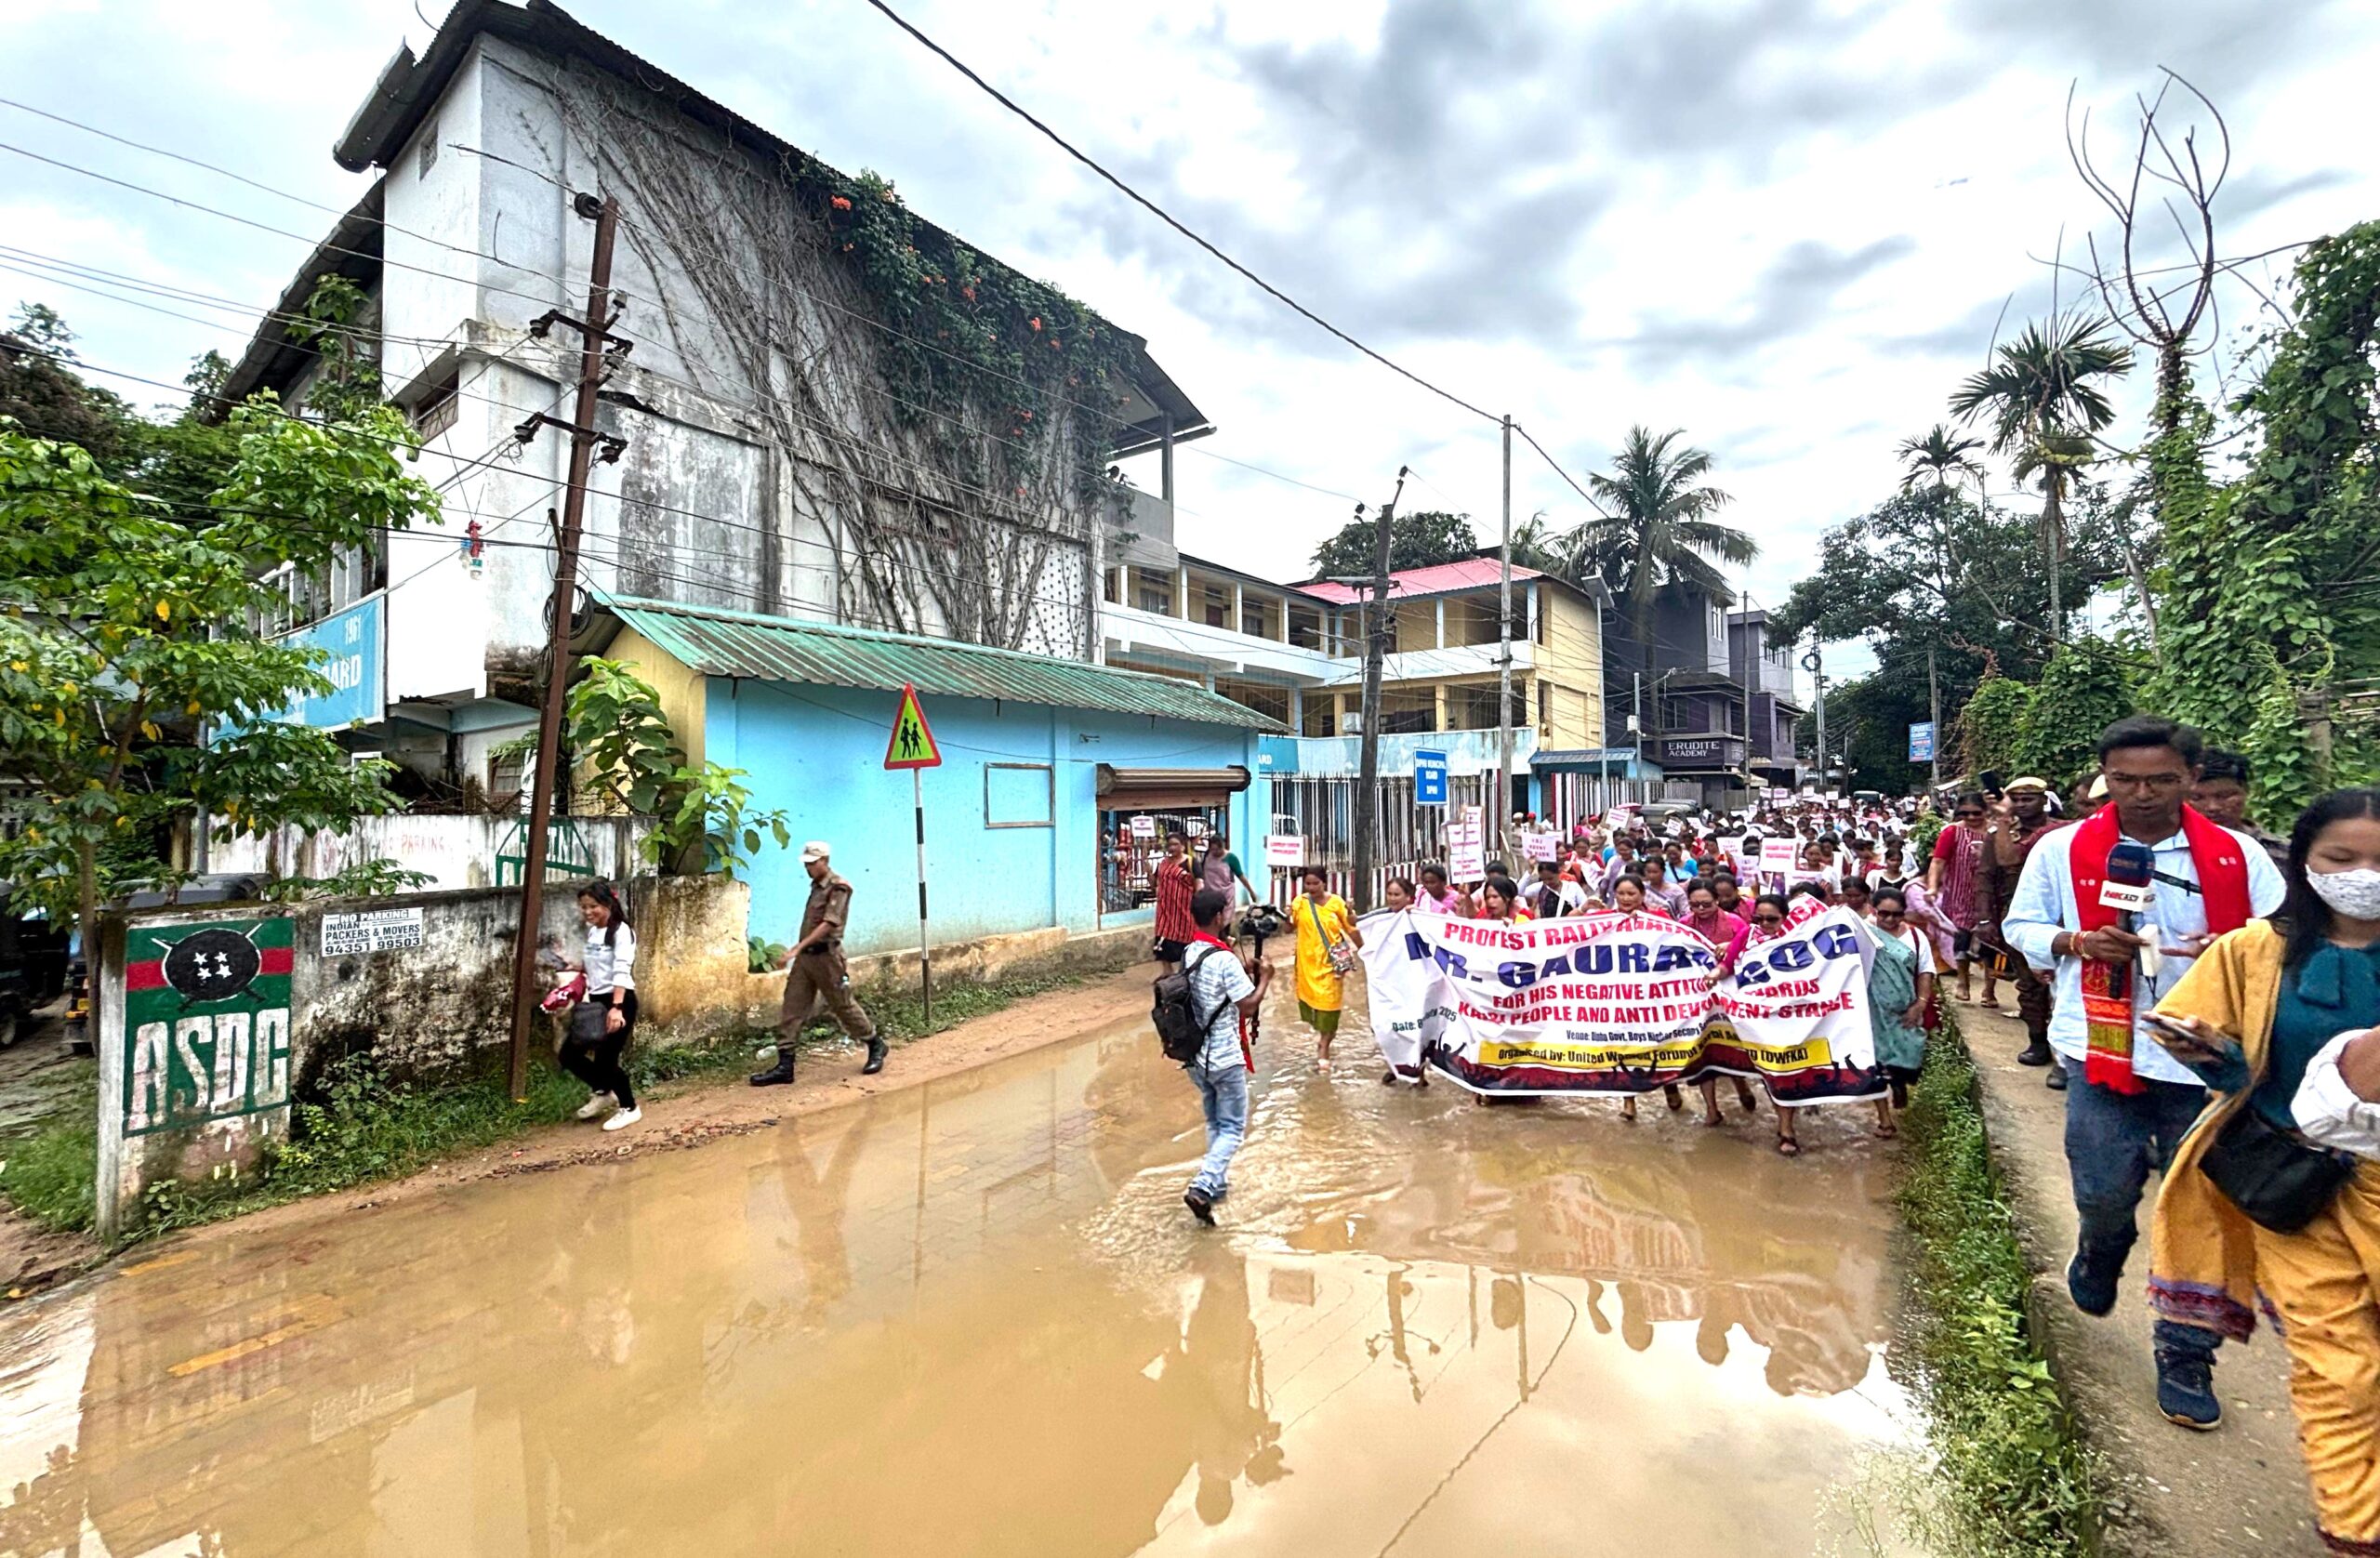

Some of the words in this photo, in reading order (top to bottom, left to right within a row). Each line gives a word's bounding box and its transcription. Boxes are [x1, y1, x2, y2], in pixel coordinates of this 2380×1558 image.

[1668, 741, 1720, 750] ERUDITE
[340, 914, 357, 923] NO
[360, 911, 408, 921] PARKING
[326, 929, 369, 941] PACKERS
[373, 928, 379, 936] &
[383, 924, 420, 935] MOVERS
[1445, 922, 1537, 951] PROTEST
[325, 943, 370, 955] 94351
[377, 938, 420, 949] 99503
[1493, 994, 1526, 1010] FOR
[1529, 984, 1557, 1004] HIS
[1562, 984, 1645, 1000] NEGATIVE
[1511, 1005, 1572, 1025] PEOPLE
[1577, 1007, 1609, 1023] AND
[1614, 1007, 1659, 1023] ANTI
[1628, 1032, 1646, 1042] Boys
[1568, 1051, 1604, 1063] United
[127, 1008, 289, 1130] ASDC
